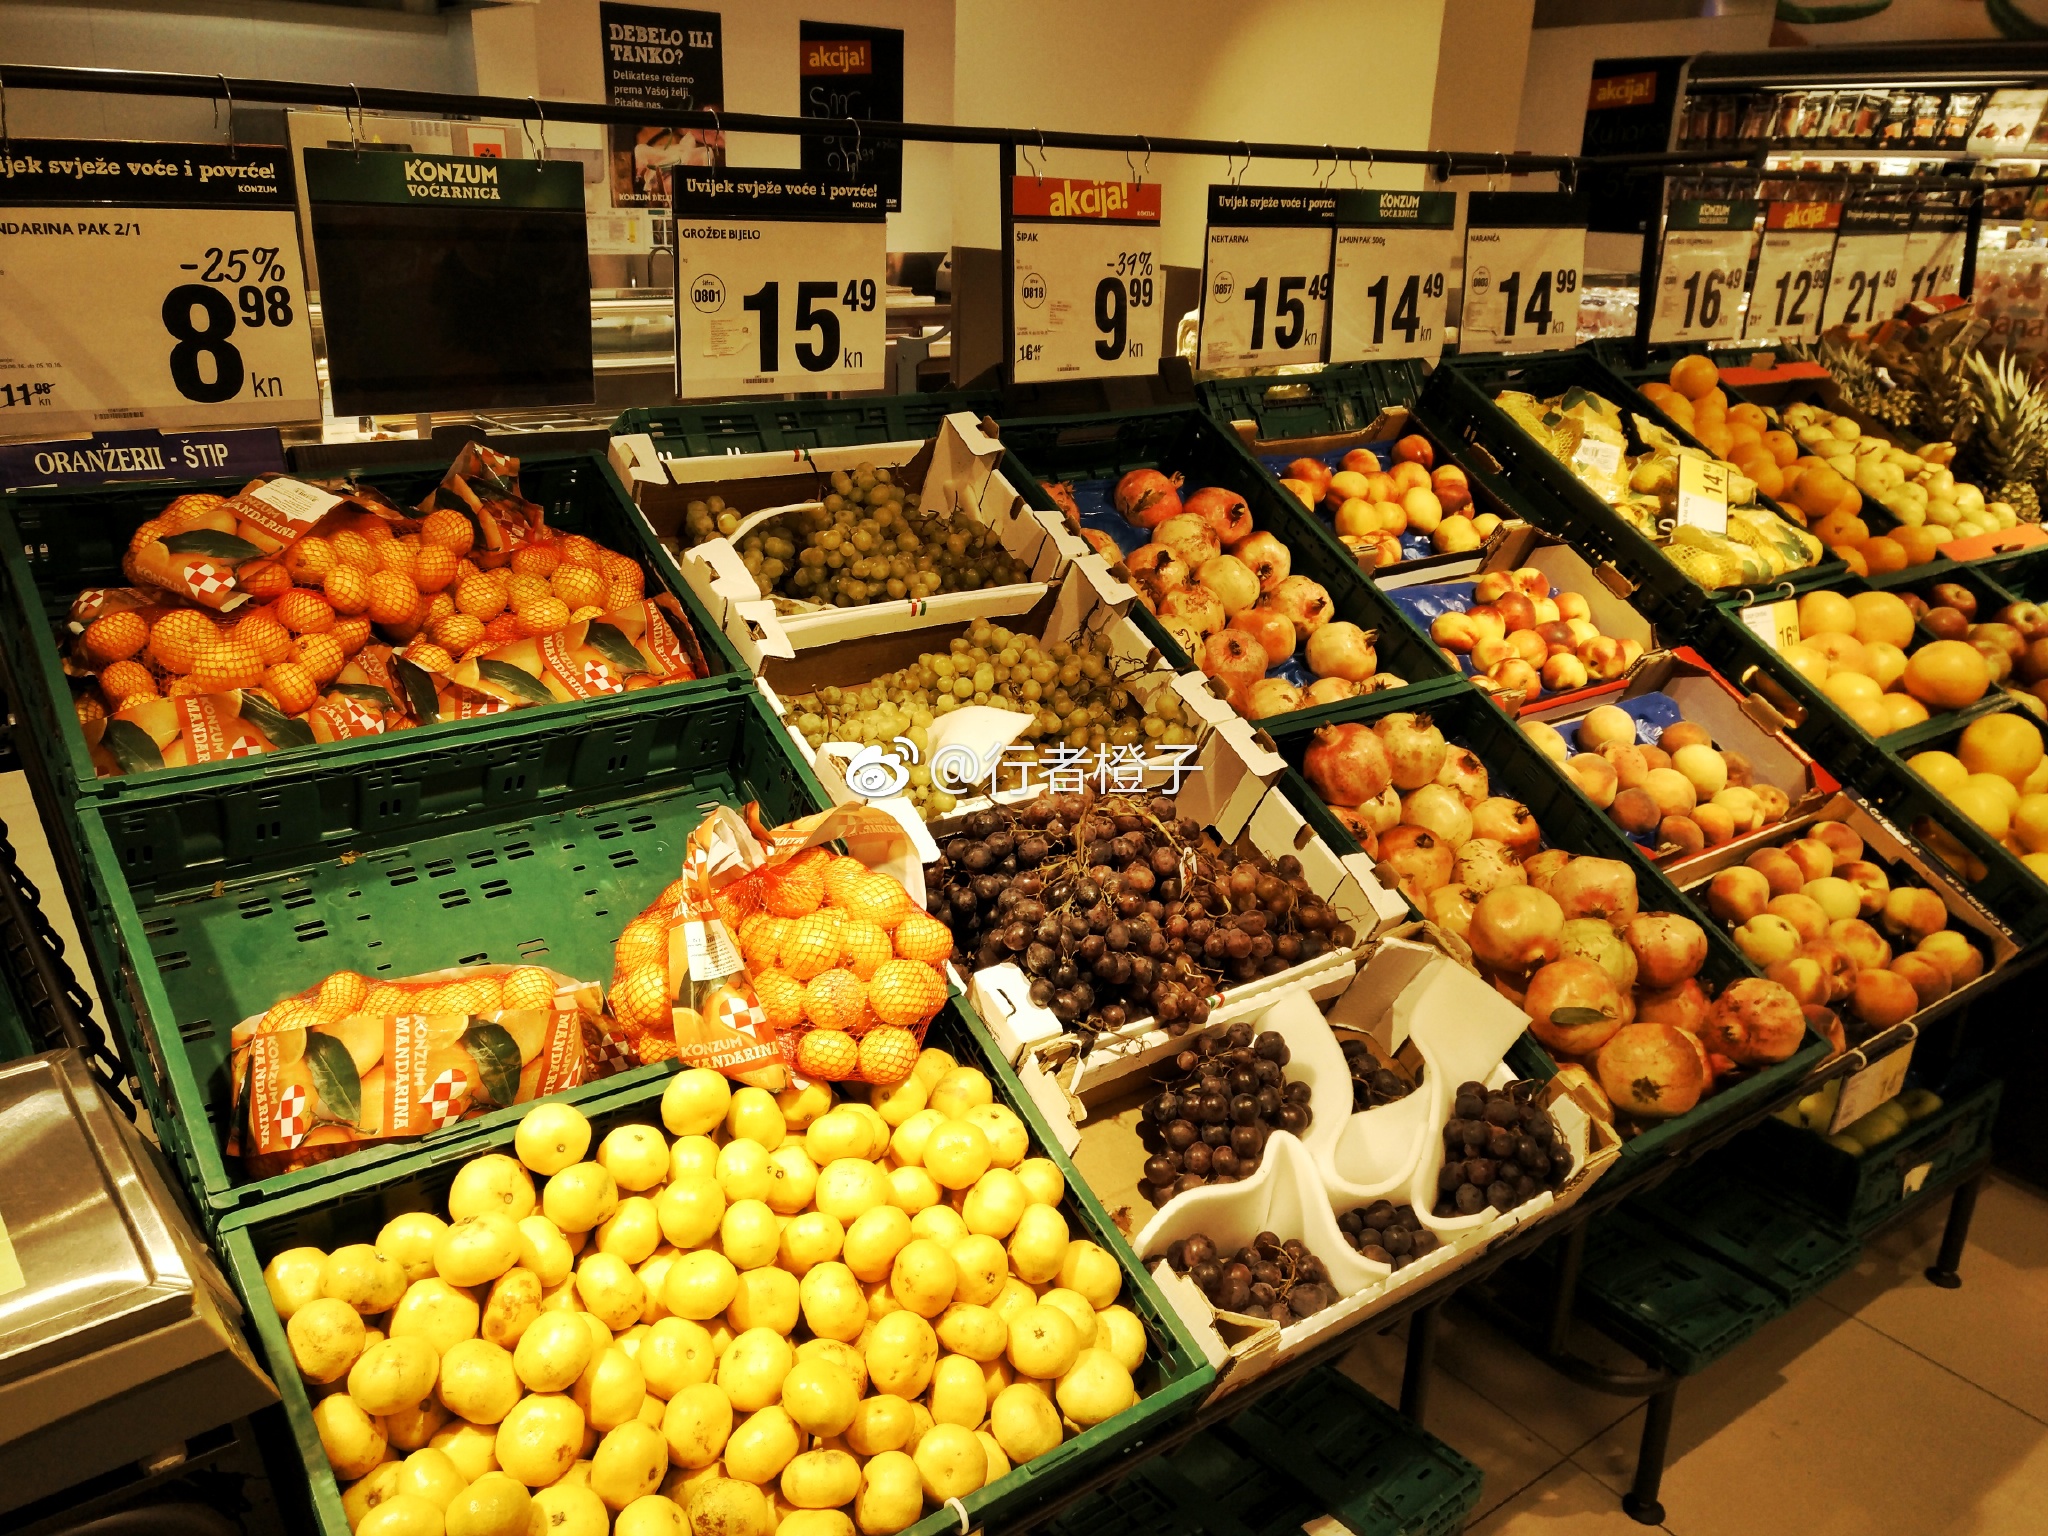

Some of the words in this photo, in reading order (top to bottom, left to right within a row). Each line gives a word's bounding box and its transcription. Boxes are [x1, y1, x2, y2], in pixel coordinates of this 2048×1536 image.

[608, 22, 683, 46] DEBELO
[688, 30, 713, 49] ILI
[610, 44, 683, 65] TANKO?
[809, 45, 865, 72] akcija!
[613, 69, 660, 83] Delikatese
[662, 72, 694, 84] režemo
[614, 86, 642, 98] prema
[645, 86, 669, 99] Vašoj
[1596, 75, 1649, 103] akcija!
[50, 157, 120, 179] svježe
[127, 159, 178, 177] voće
[184, 159, 193, 177] i
[199, 161, 276, 182] povrće!
[404, 158, 498, 184] KONZUM
[238, 184, 277, 194] KONZUM
[407, 183, 501, 200] VOĆARNICA
[686, 178, 733, 197] Uvijek
[737, 180, 781, 199] svježe
[785, 182, 817, 196] voće
[820, 183, 826, 196] i
[830, 183, 878, 200] povrće!
[1050, 179, 1129, 218] akcija!
[1379, 192, 1420, 209] KONZUM
[852, 201, 877, 209] KONZUM
[1219, 195, 1249, 210] Uvijek
[1250, 196, 1279, 211] svježe
[1281, 197, 1301, 209] voće
[1302, 197, 1307, 208] i
[1784, 202, 1828, 229] akcija!
[78, 223, 110, 236] PAK
[114, 223, 141, 237] 2/1
[729, 229, 761, 241] BIJELO
[1016, 232, 1038, 242] ŠIPAK
[1211, 235, 1249, 244] NEKTARINA
[1339, 236, 1359, 244] LIMUN
[1359, 236, 1371, 244] PAK
[180, 247, 286, 283] -25%
[1106, 252, 1152, 276] -39%
[694, 289, 721, 303] 0801
[1023, 287, 1044, 299] 0818
[1499, 271, 1552, 336] 14
[1556, 269, 1577, 293] 99
[1683, 268, 1725, 329] 16
[1726, 267, 1742, 289] 49
[1775, 270, 1812, 326] 12
[1843, 270, 1881, 324] 21
[1094, 277, 1127, 361] 9
[1129, 278, 1153, 308] 99
[1244, 276, 1307, 350] 15
[1308, 273, 1329, 301] 49
[1367, 275, 1420, 344] 14
[1423, 272, 1444, 298] 49
[743, 281, 841, 372] 15
[842, 278, 876, 312] 49
[1420, 325, 1432, 342] kn
[1552, 320, 1564, 334] kn
[161, 283, 244, 403] 8
[239, 285, 293, 327] 98
[1129, 339, 1143, 358] kn
[1304, 329, 1317, 346] kn
[844, 347, 863, 369] kn
[0, 383, 31, 407] 11
[252, 372, 283, 398] kn
[38, 397, 51, 406] kn
[34, 442, 165, 475] ORANŽERII
[181, 439, 228, 469] ŠTIP
[1702, 473, 1723, 494] 14
[1779, 626, 1794, 647] 16
[554, 630, 578, 677] KONZUM
[199, 696, 226, 753] KONZUM
[413, 1014, 429, 1087] KONZUM
[559, 1011, 579, 1077] KONZUM
[681, 1035, 743, 1058] KONZUM
[266, 1035, 280, 1105] KONZUM
[393, 1016, 411, 1130] MANDARINA
[254, 1038, 271, 1149] MANDARINA
